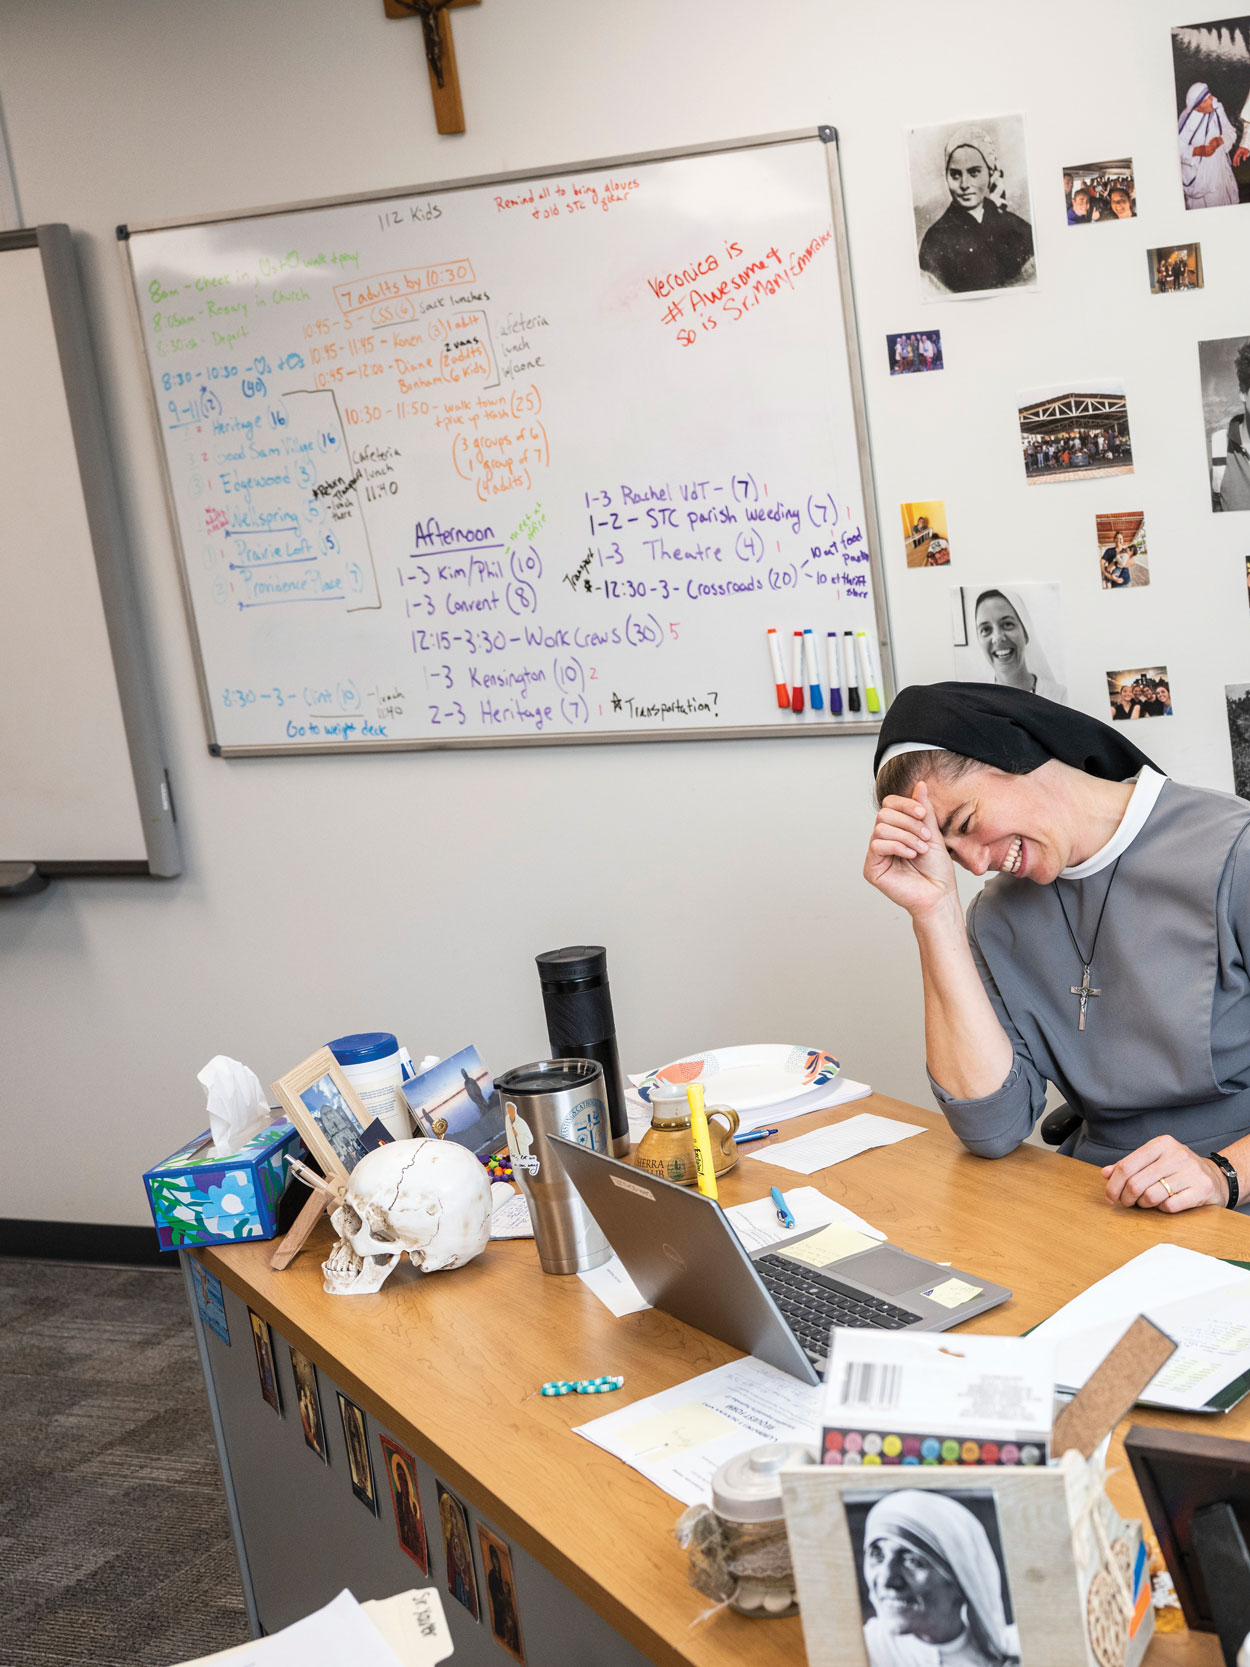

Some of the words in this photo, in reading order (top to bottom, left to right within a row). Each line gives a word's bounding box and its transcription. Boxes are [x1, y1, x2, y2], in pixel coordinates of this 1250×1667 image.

[494, 189, 534, 213] Remind
[539, 187, 550, 199] all
[556, 185, 566, 196] to
[604, 178, 640, 196] gloves
[378, 214, 404, 232] 112
[411, 204, 443, 222] Kids
[341, 291, 352, 307] 7
[358, 280, 400, 304] adults
[404, 274, 421, 290] by
[426, 265, 467, 286] 10:30
[648, 255, 719, 299] Veronica
[724, 240, 743, 260] is
[700, 313, 717, 331] is
[345, 406, 382, 425] 10:30
[397, 402, 429, 420] 11:50
[444, 400, 472, 413] walk
[476, 396, 507, 409] town
[213, 416, 261, 444] Heritage
[473, 435, 513, 464] groups
[483, 457, 513, 482] group
[585, 490, 612, 508] 1-3
[621, 482, 672, 506] Rachel
[732, 472, 759, 502] (7)
[590, 512, 623, 536] 1-2
[646, 508, 679, 528] STC
[686, 506, 738, 529] parish
[745, 502, 801, 534] weeding
[807, 493, 838, 528] (7)
[415, 517, 496, 548] Afternoon
[597, 542, 625, 567] 1-3
[642, 539, 723, 562] Theatre
[735, 528, 765, 563] (4)
[398, 566, 431, 587] 1-3
[437, 554, 504, 587] Kim/Phil
[511, 545, 543, 582] (10)
[686, 576, 764, 599] Crossroads
[768, 564, 798, 590] (20)
[817, 571, 827, 585] 10
[405, 594, 436, 618] 1-3
[446, 593, 500, 616] Convent
[506, 581, 537, 616] (8)
[625, 613, 665, 648] (30)
[669, 622, 680, 640] 5
[469, 666, 546, 700] Kensington
[553, 656, 586, 695] (10)
[589, 667, 599, 680] 2
[286, 720, 305, 738] Go
[428, 701, 466, 725] 2-3
[480, 700, 552, 730] Heritage
[560, 693, 589, 724] (7)
